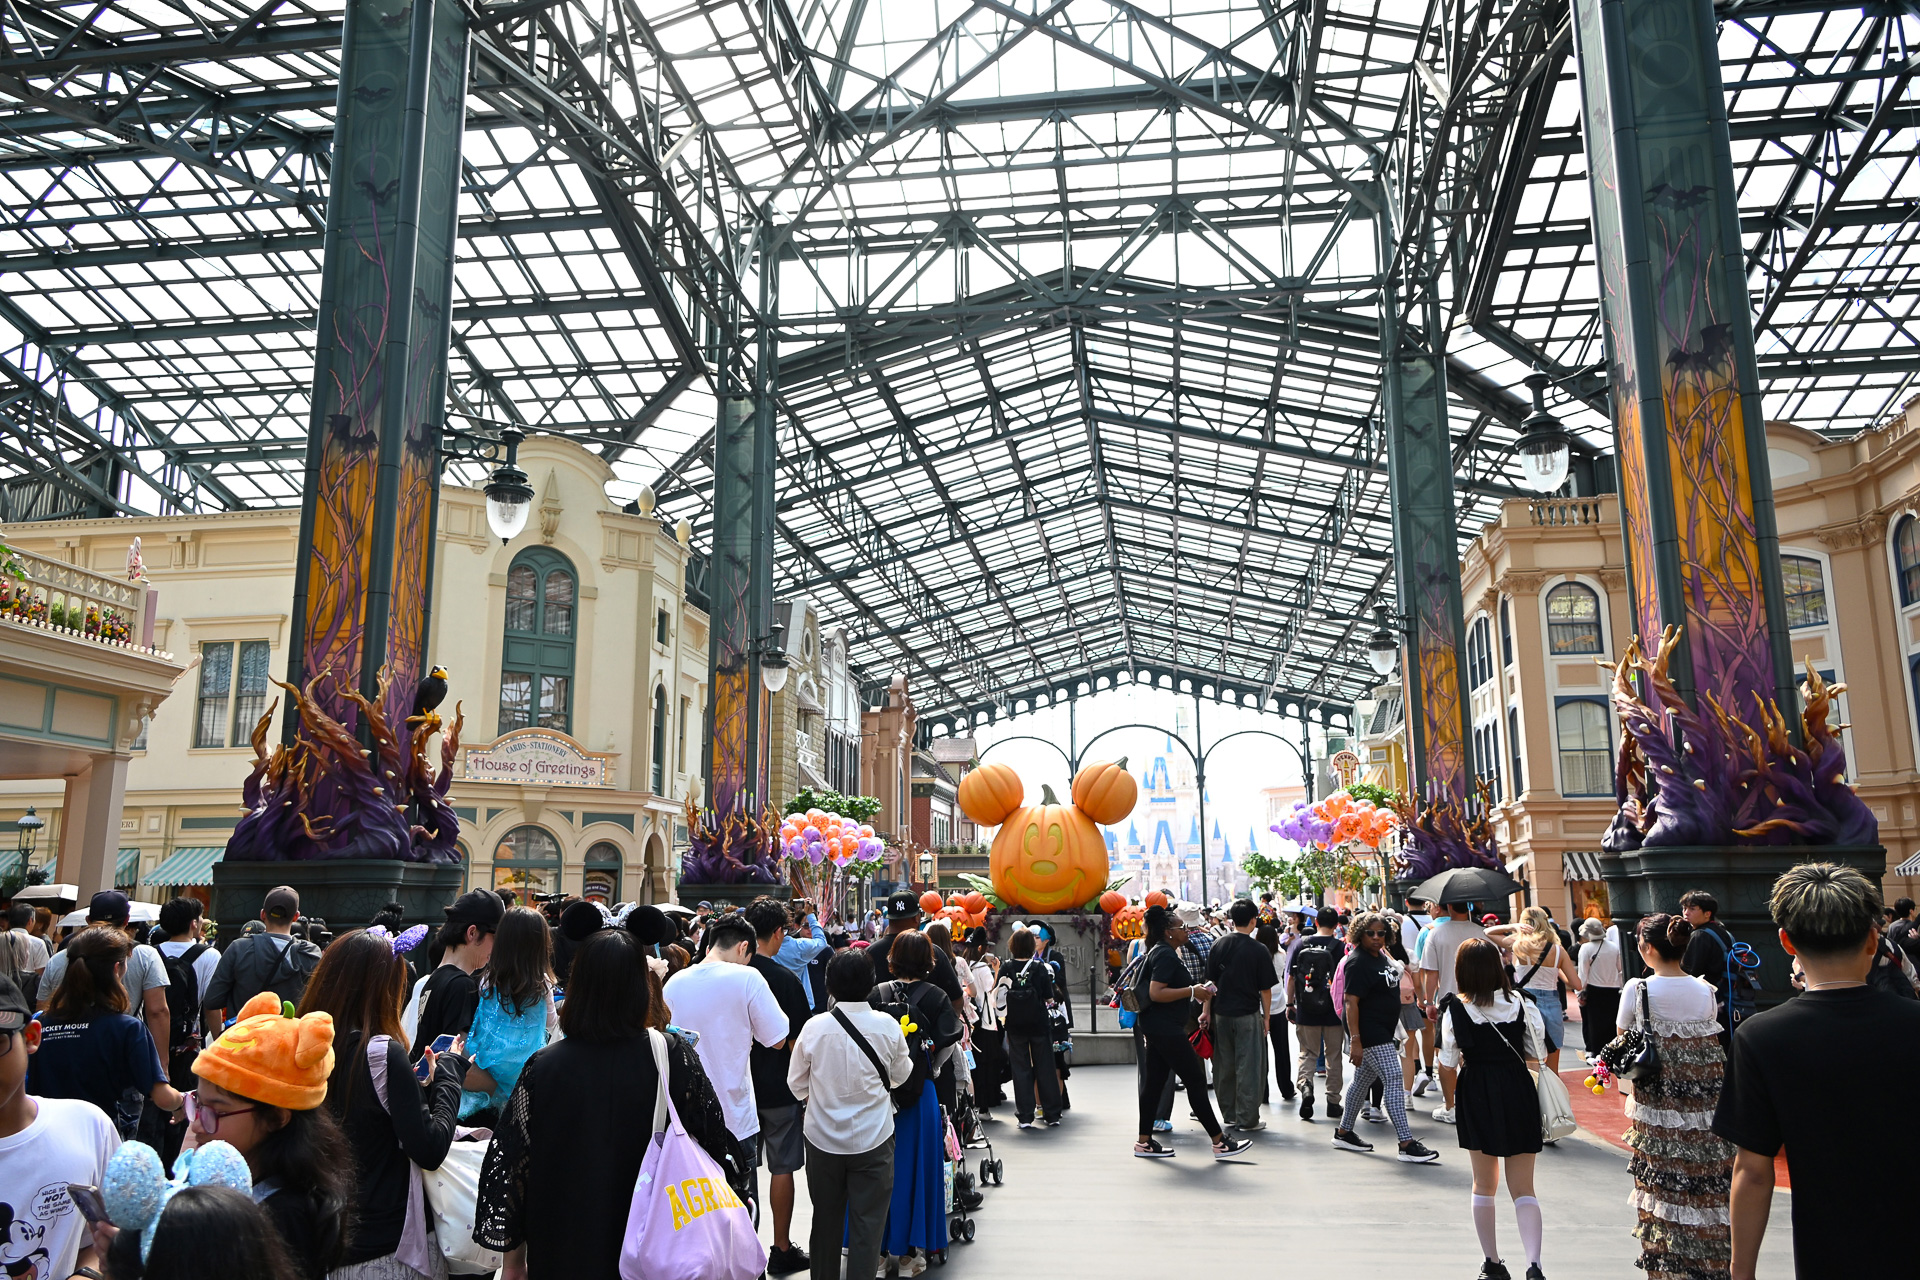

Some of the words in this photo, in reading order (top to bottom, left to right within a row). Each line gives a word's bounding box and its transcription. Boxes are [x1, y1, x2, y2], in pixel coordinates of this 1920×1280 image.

[505, 741, 569, 758] CARDS-STATIONERY
[473, 757, 517, 773] House
[519, 758, 533, 775] of
[535, 760, 596, 779] Greetings
[895, 900, 905, 911] NY
[64, 1022, 90, 1030] MOUSE
[42, 1188, 57, 1197] NICE
[44, 1192, 66, 1204] NOT
[52, 1198, 72, 1208] SAME
